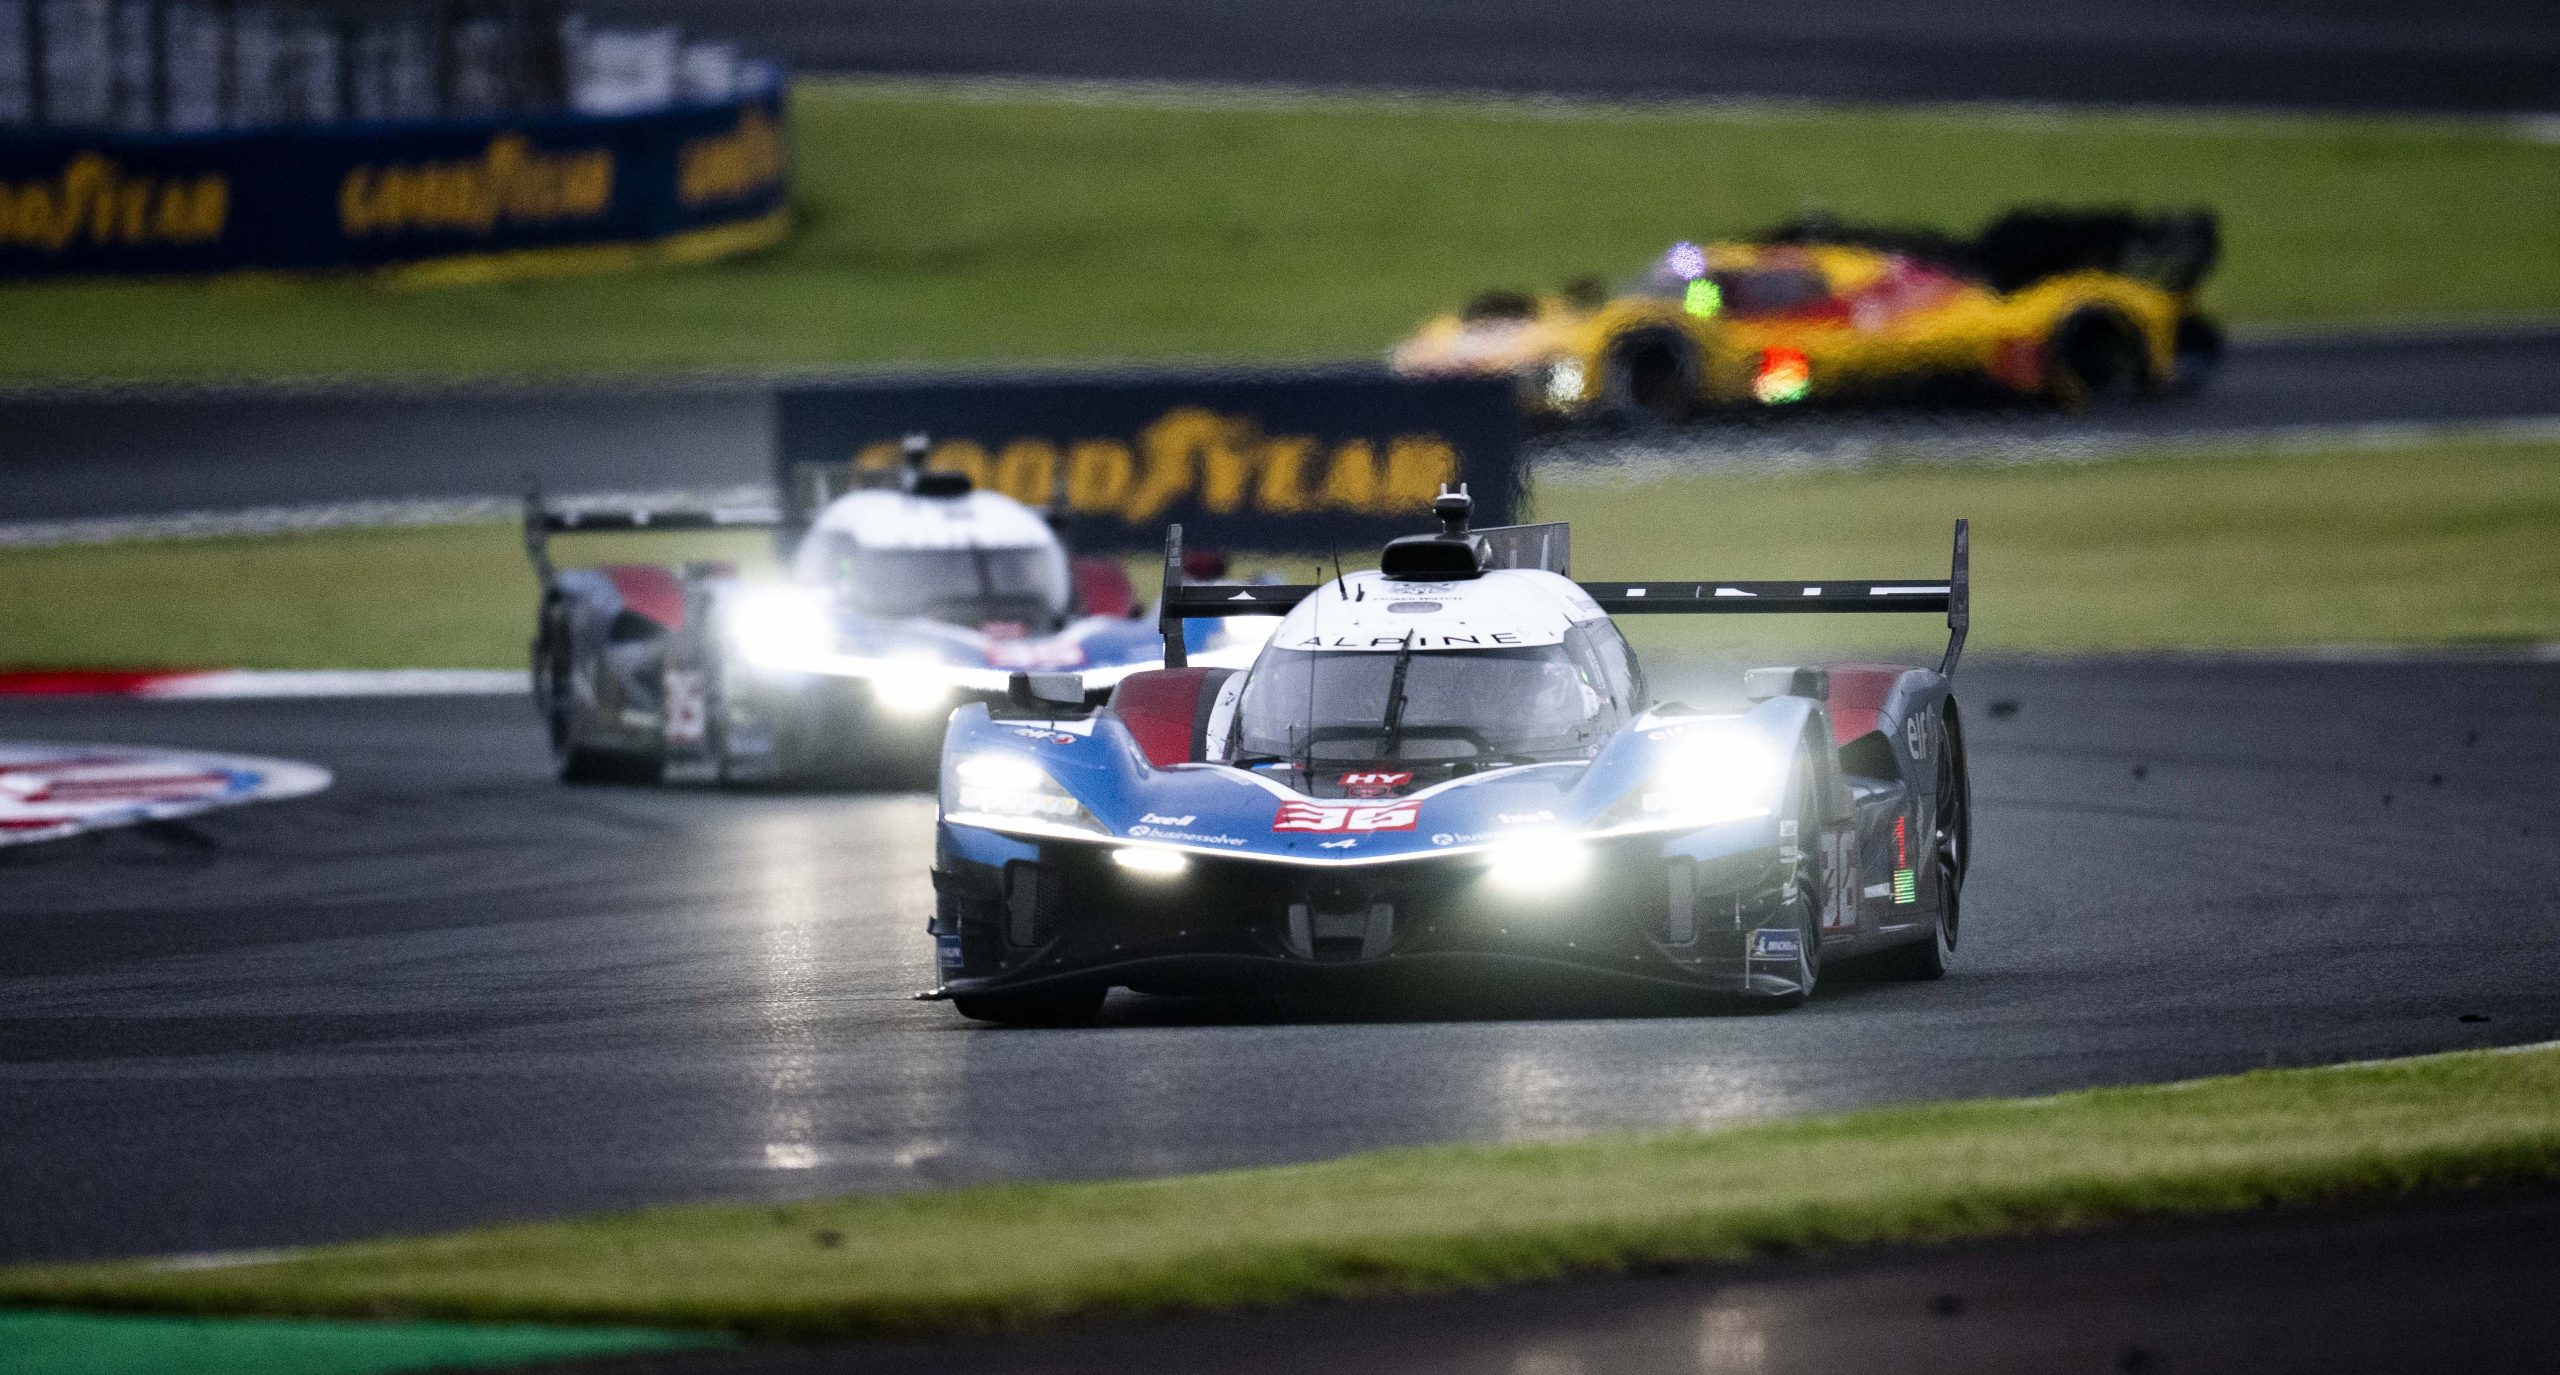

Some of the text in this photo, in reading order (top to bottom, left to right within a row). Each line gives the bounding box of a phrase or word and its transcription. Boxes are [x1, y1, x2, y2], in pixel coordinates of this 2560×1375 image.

[1298, 632, 1521, 647] ALPINE
[1907, 711, 1927, 759] elf
[1346, 774, 1407, 784] HY
[1274, 801, 1422, 830] 36
